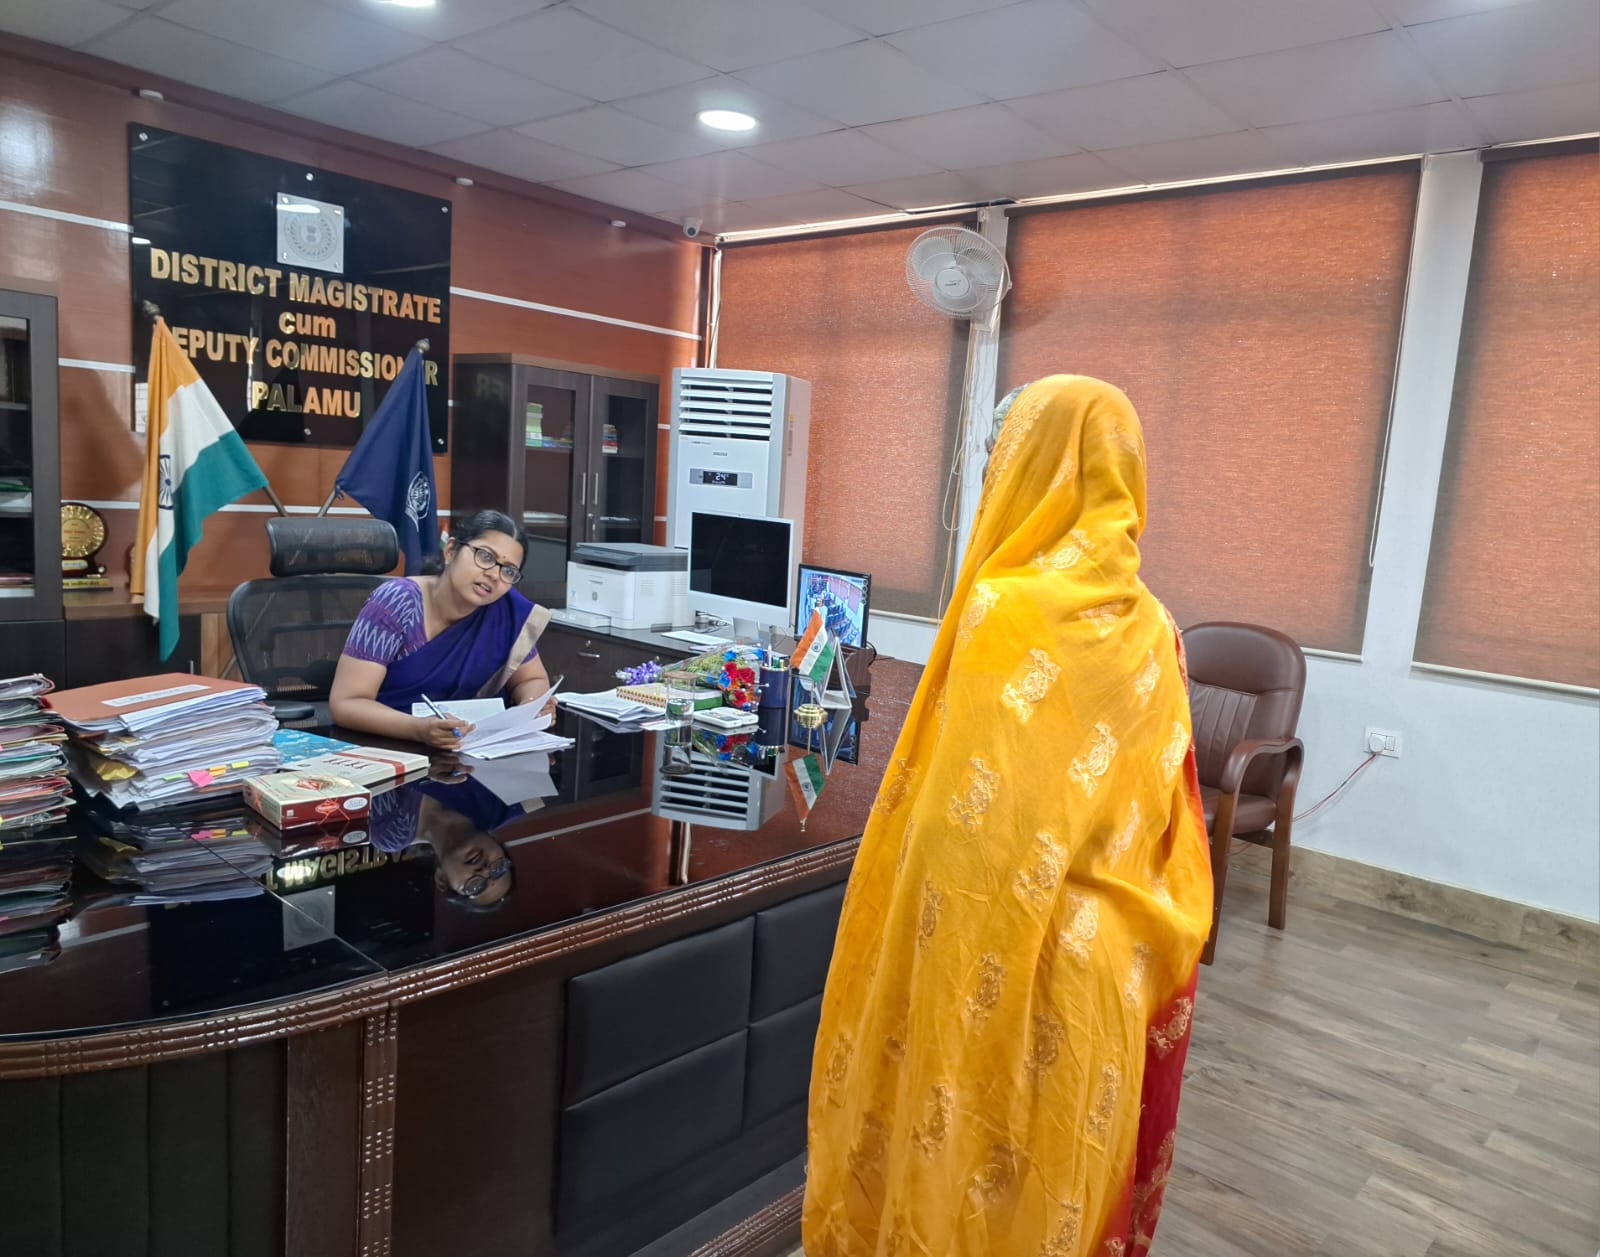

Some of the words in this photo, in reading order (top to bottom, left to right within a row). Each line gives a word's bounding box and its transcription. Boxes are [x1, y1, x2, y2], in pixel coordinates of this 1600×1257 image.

[150, 247, 282, 298] DISTRICT
[289, 271, 441, 324] MAGISTRATE
[279, 311, 336, 338] cum
[153, 324, 259, 365] EPUTY
[265, 339, 439, 386] COMMISSIOR
[251, 380, 361, 418] PALAMU
